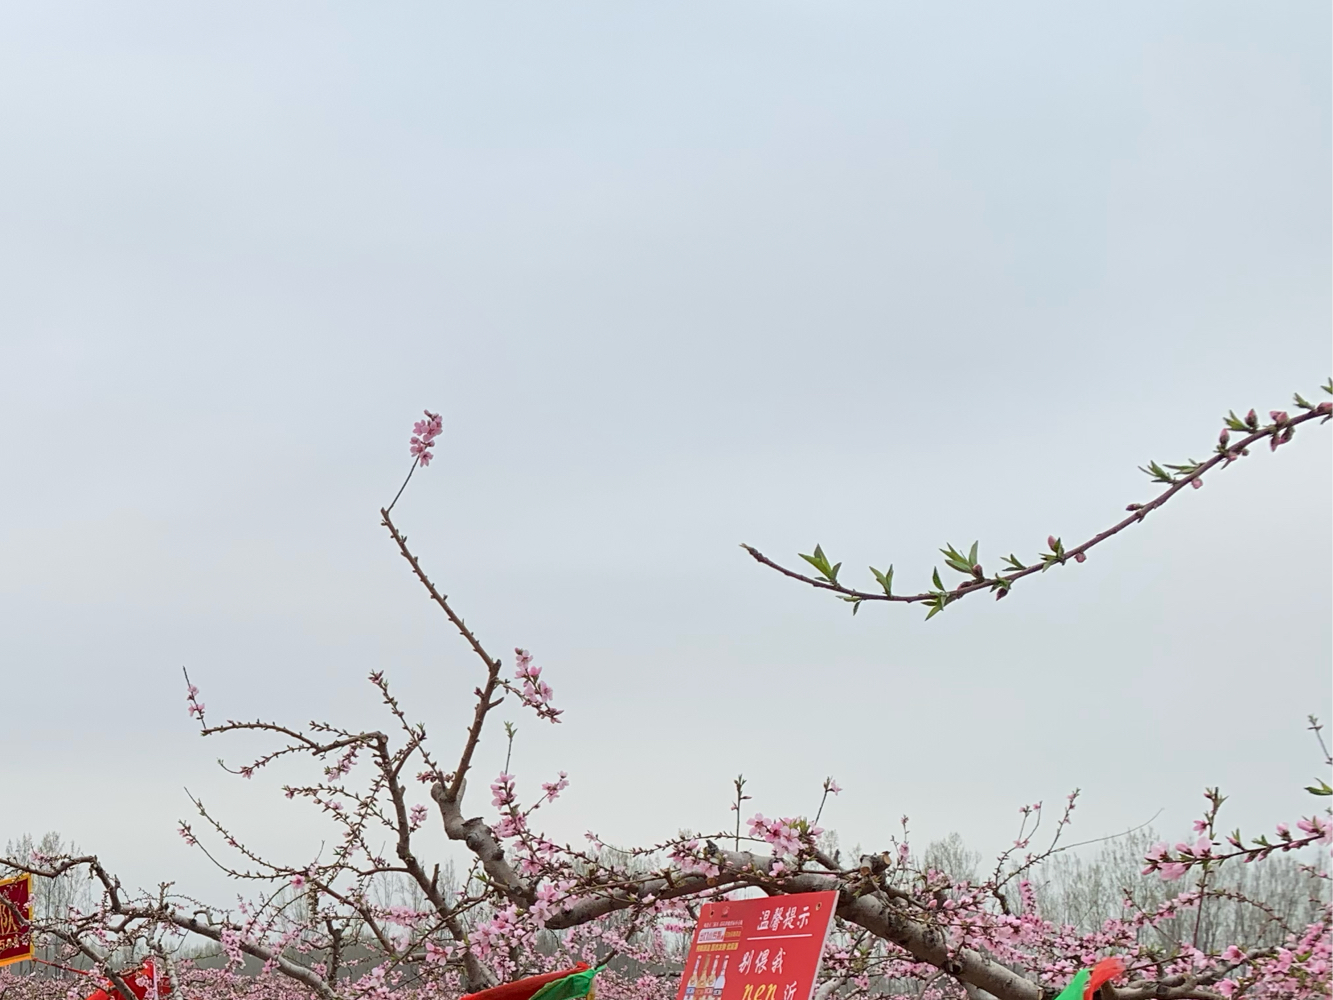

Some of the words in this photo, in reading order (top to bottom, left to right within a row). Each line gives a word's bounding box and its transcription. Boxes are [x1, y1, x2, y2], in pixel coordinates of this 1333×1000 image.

[756, 905, 811, 931] 温馨提示
[738, 947, 786, 975] 别偎我
